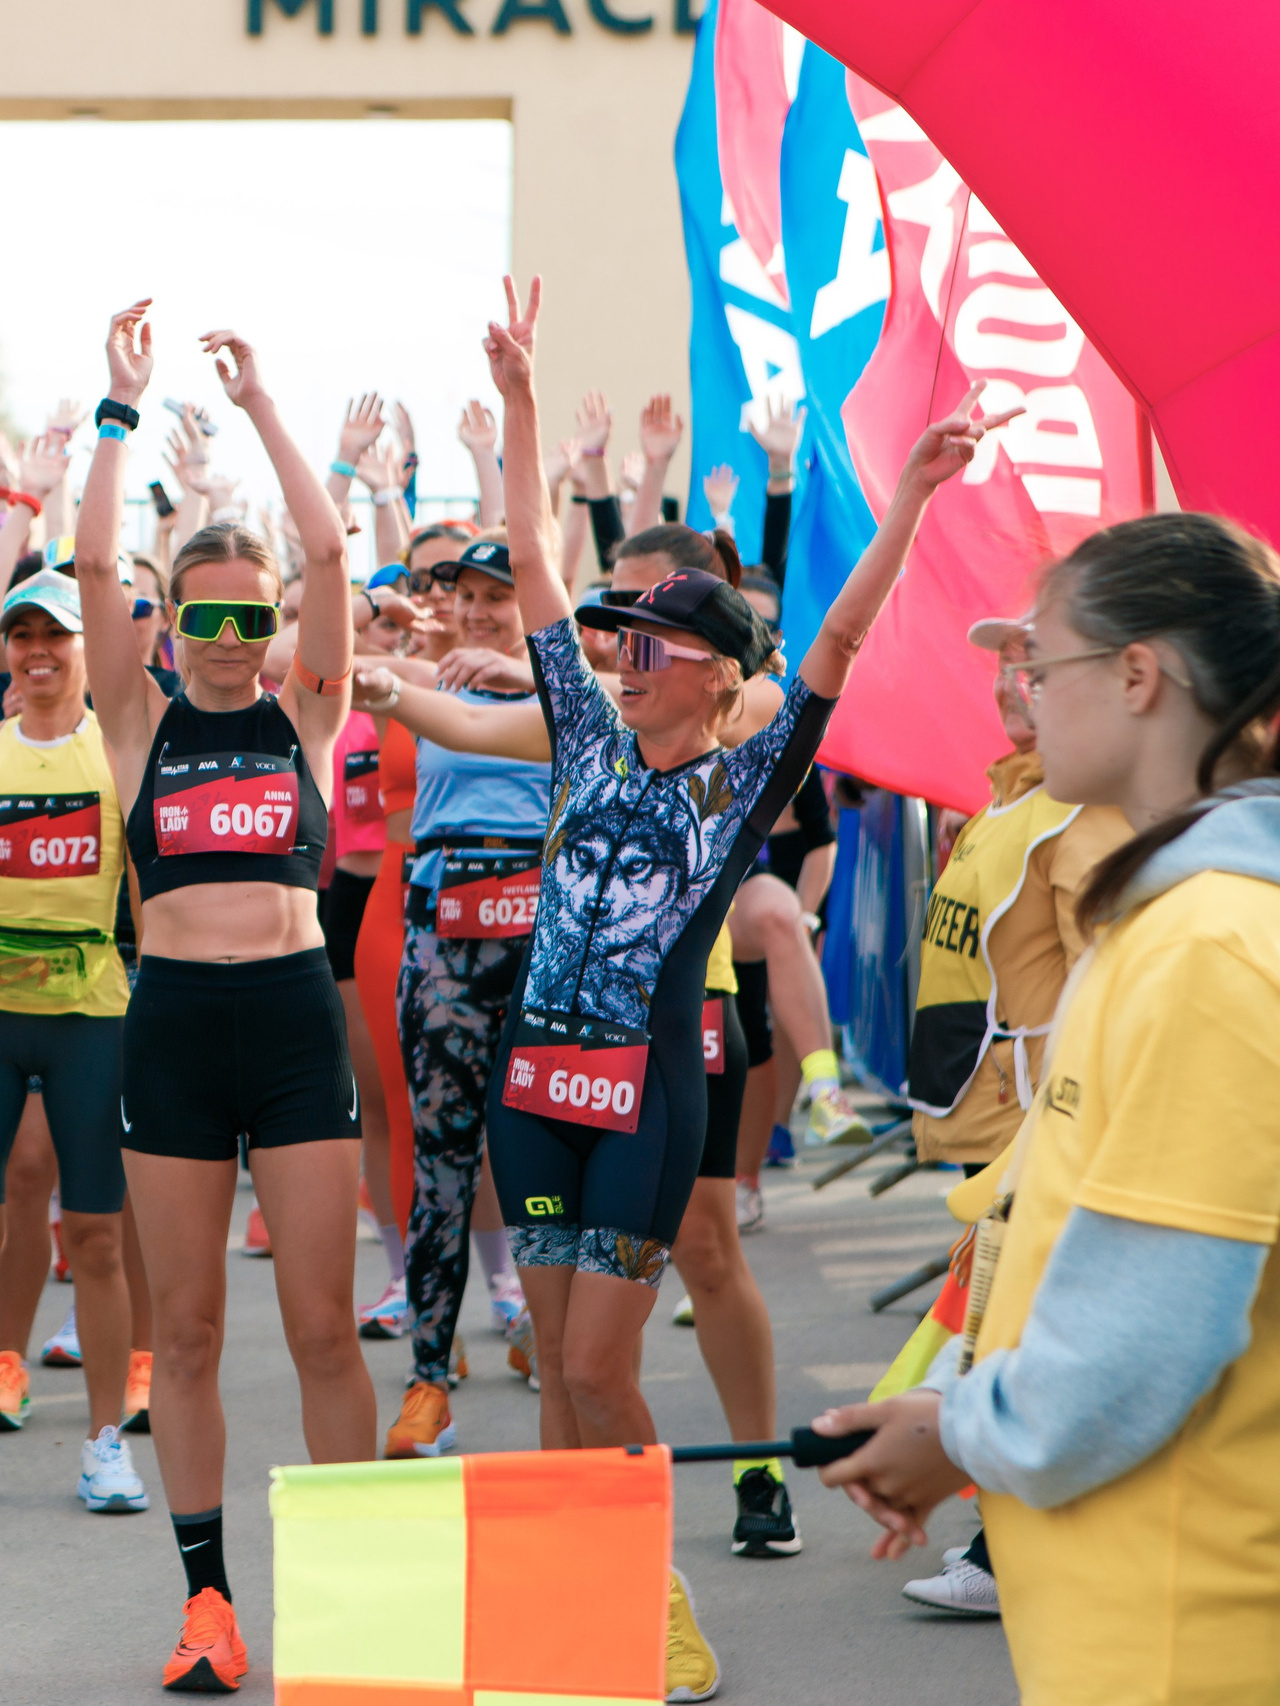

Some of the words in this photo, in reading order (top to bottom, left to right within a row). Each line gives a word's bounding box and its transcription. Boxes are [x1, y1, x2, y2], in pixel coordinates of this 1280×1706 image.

[198, 761, 218, 771] AVA
[255, 762, 276, 771] VOICE
[17, 800, 36, 808] AVA
[264, 790, 292, 802] ANNA
[160, 806, 180, 818] IRON
[210, 803, 293, 838] 6067
[160, 816, 189, 833] LADY
[29, 835, 97, 866] 6072
[478, 896, 540, 926] 6023
[550, 1021, 567, 1033] AVA
[604, 1032, 627, 1043] VOICE
[513, 1057, 529, 1072] IRON
[510, 1070, 535, 1089] LADY
[548, 1069, 635, 1115] 6090
